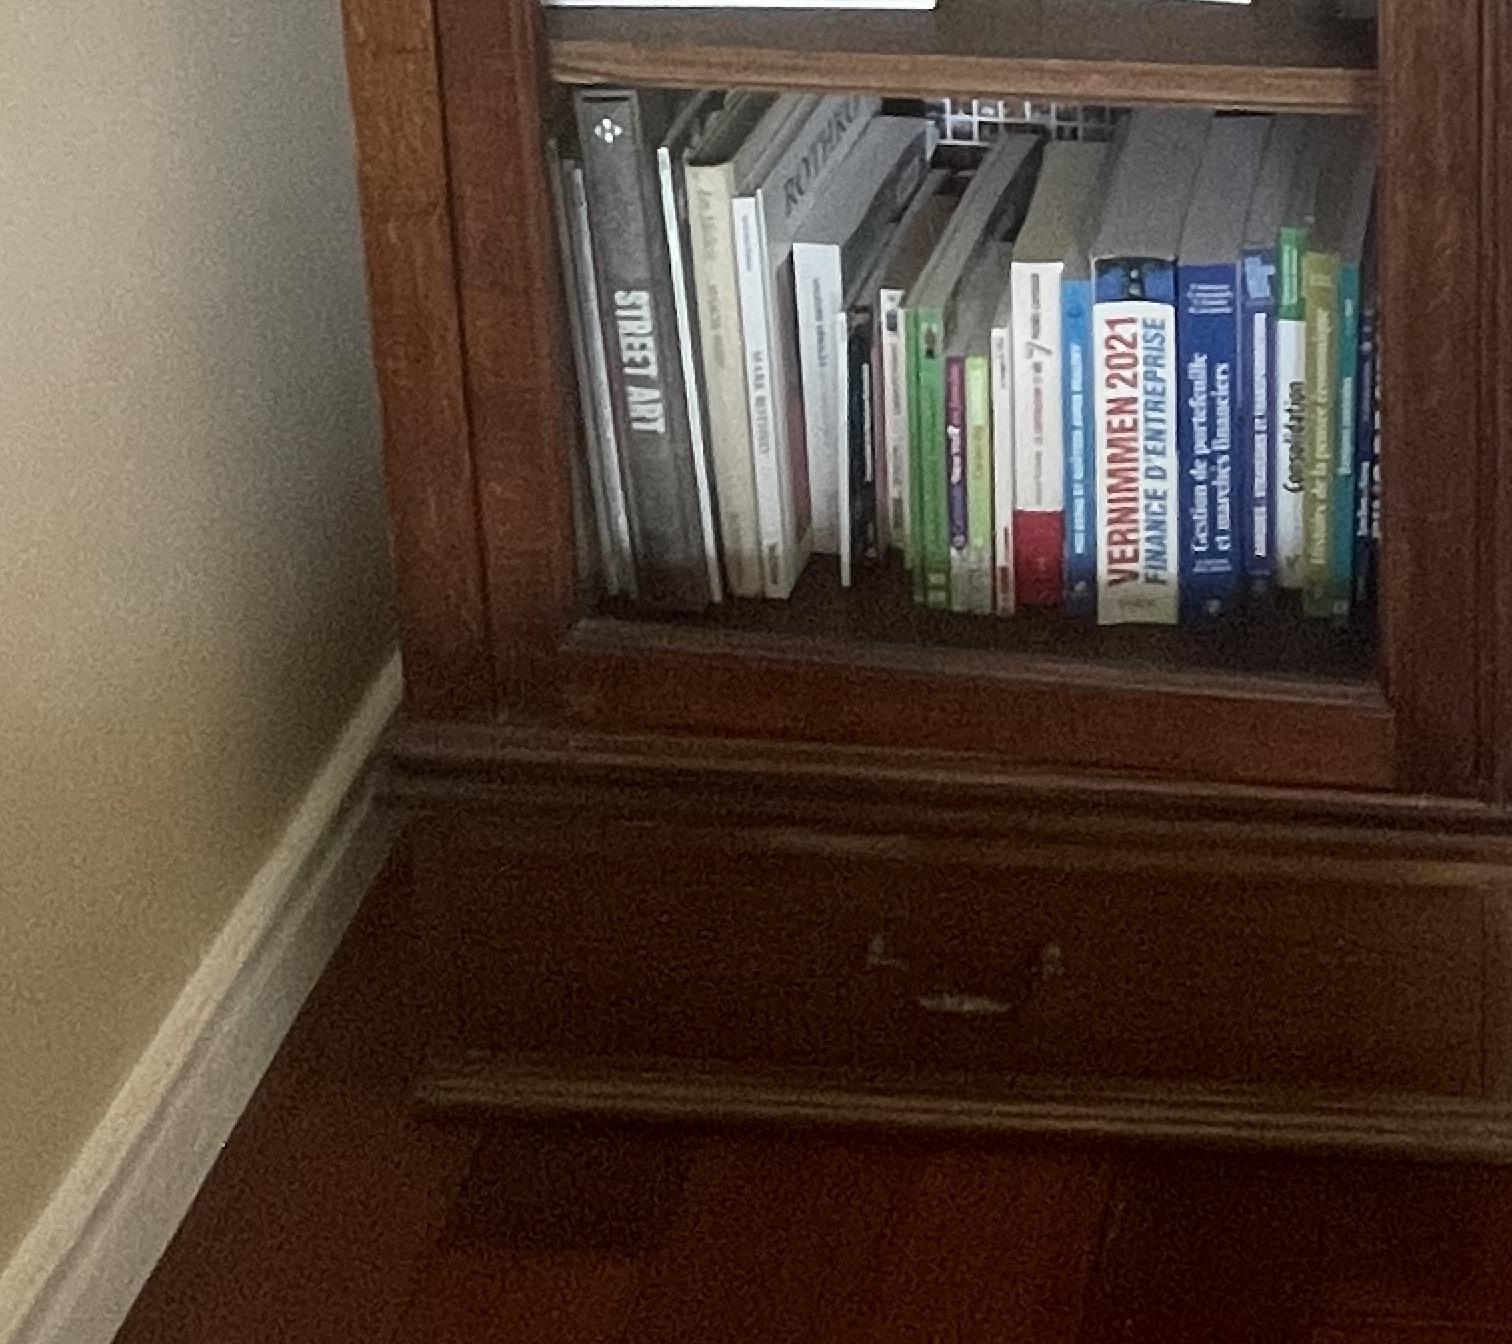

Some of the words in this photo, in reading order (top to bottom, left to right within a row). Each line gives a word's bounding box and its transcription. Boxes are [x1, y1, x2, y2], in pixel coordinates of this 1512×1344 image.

[614, 290, 657, 378] STREET
[1105, 316, 1139, 390] 2021
[626, 385, 666, 434] ART
[1142, 317, 1168, 481] D'ENTREPRISE
[1283, 380, 1307, 494] Consolidation
[1106, 396, 1140, 588] VERNIMMEN
[1143, 487, 1168, 586] FINANCE
